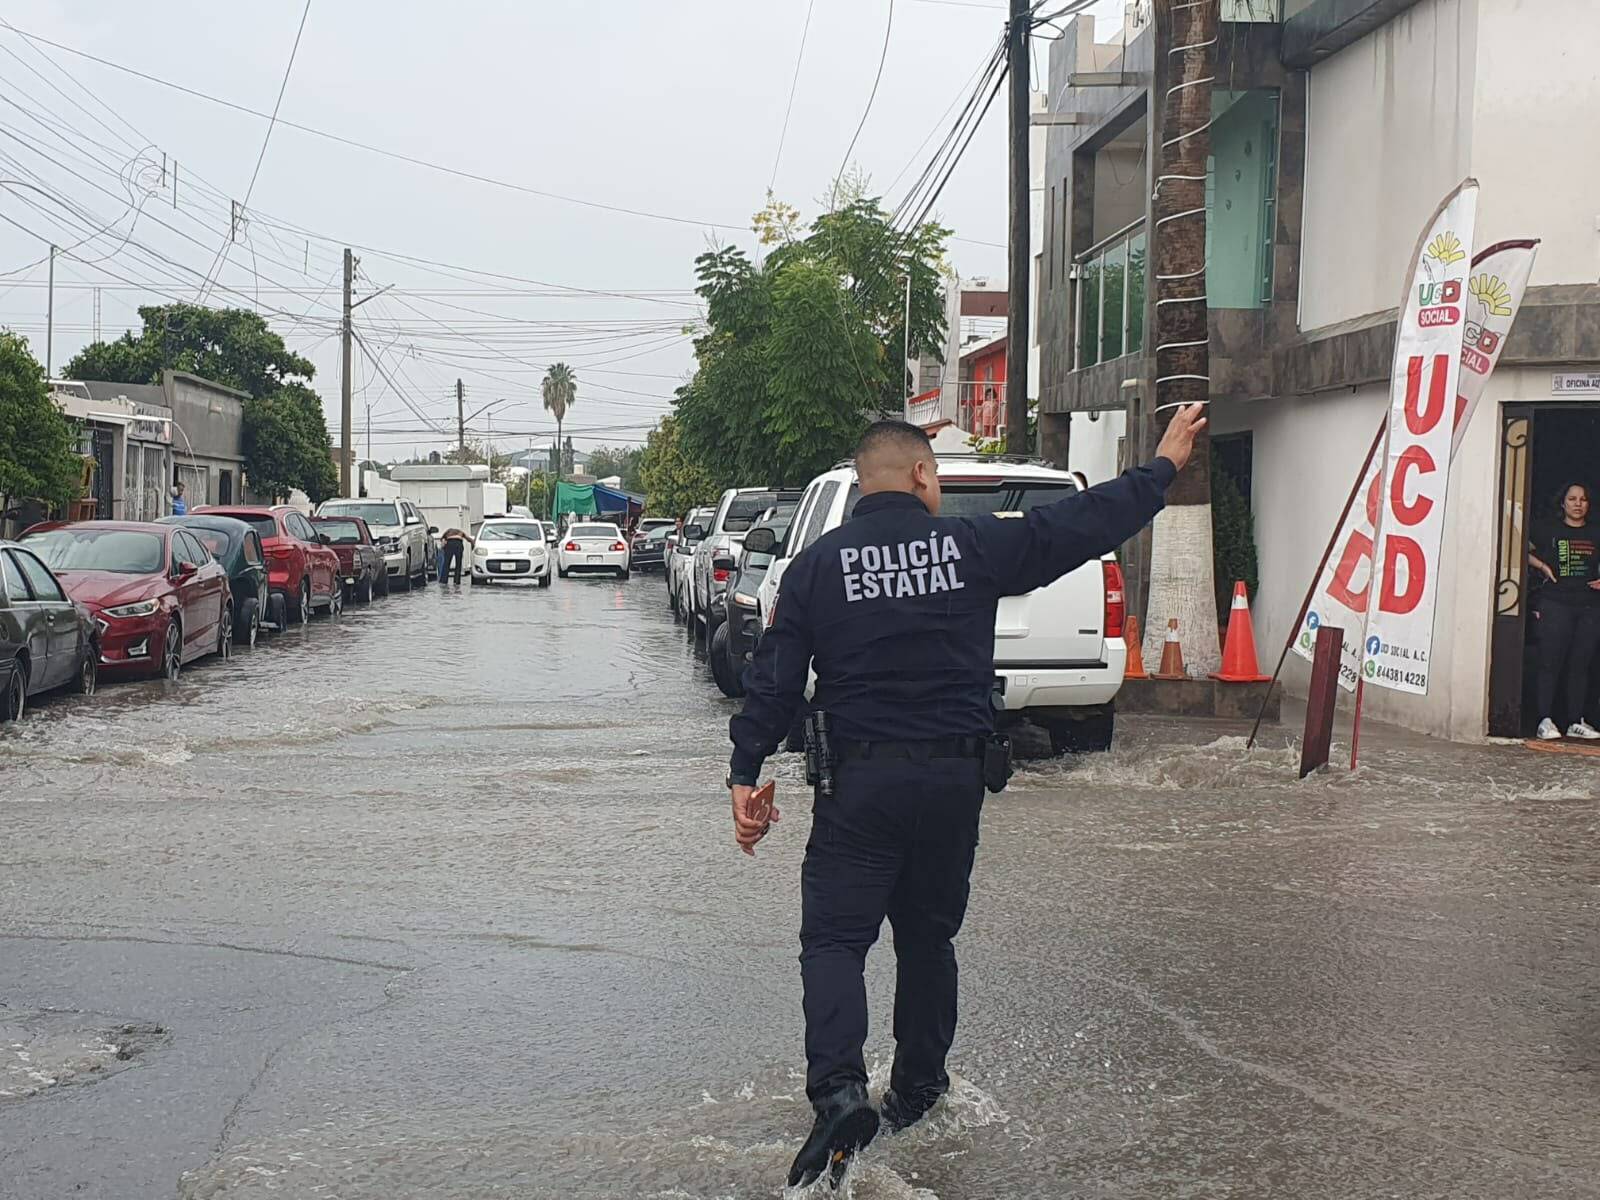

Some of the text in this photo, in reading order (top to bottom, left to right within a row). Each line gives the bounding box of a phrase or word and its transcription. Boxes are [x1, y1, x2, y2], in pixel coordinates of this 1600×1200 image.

[1419, 279, 1462, 306] UCD
[1420, 308, 1454, 325] SOCIAL
[1463, 321, 1500, 355] CD
[1566, 379, 1591, 388] OFICINA
[840, 531, 961, 573] POLICÍA
[1558, 539, 1567, 562] KIND
[844, 563, 965, 602] ESTATAL
[1390, 645, 1410, 659] SOCIAL
[1413, 649, 1428, 662] A.C.
